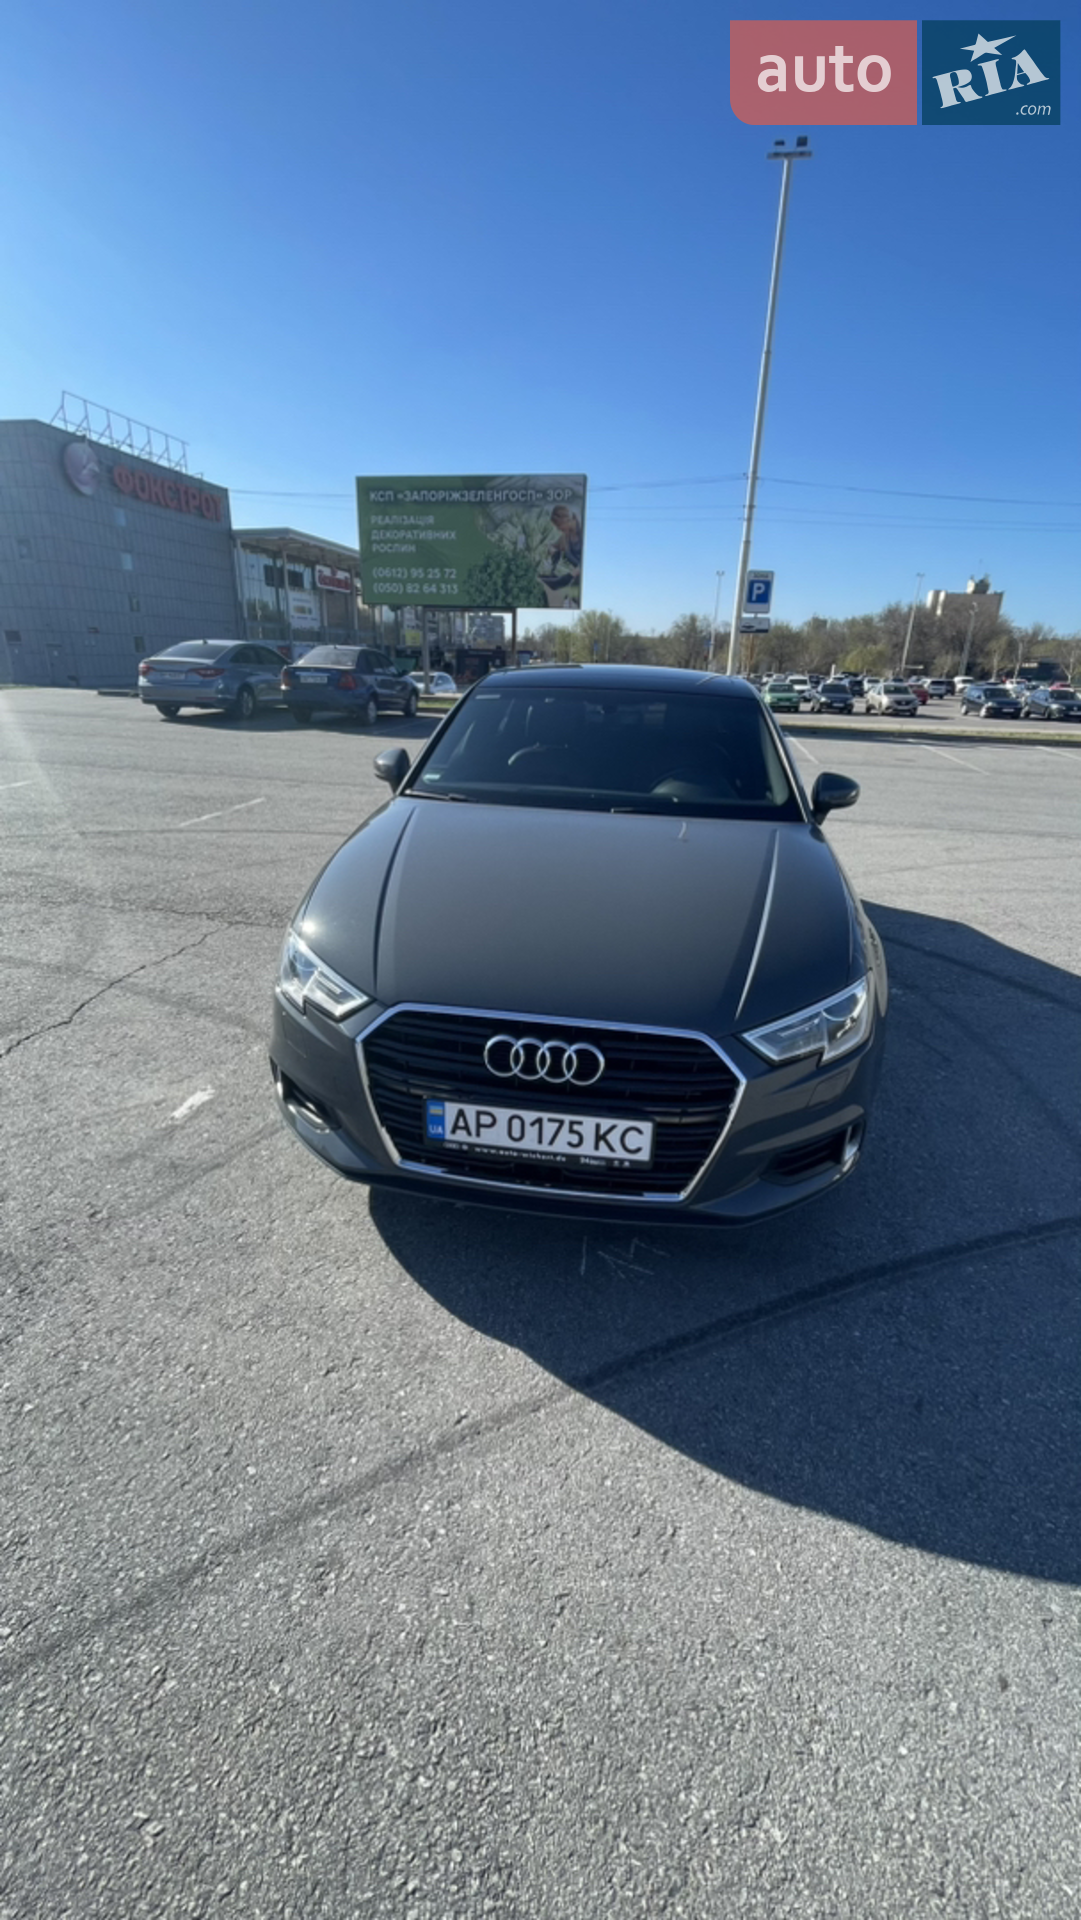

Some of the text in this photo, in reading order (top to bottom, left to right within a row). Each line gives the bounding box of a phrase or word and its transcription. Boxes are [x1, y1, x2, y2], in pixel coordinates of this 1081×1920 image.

[112, 464, 222, 522] ФОКСТРОТ
[369, 490, 394, 501] КСП
[546, 489, 573, 501] ЗОР
[371, 515, 434, 526] РЕАЛІЗАЦІЯ
[371, 530, 457, 541] ДЕКОРАТИВНИХ
[372, 543, 417, 553] РОСПИН
[372, 567, 457, 579] (0612) 95 25 72
[373, 583, 459, 595] (050) 82 64 313
[751, 582, 765, 601] P
[428, 1124, 443, 1135] UA
[450, 1108, 645, 1154] AP 0175 KC
